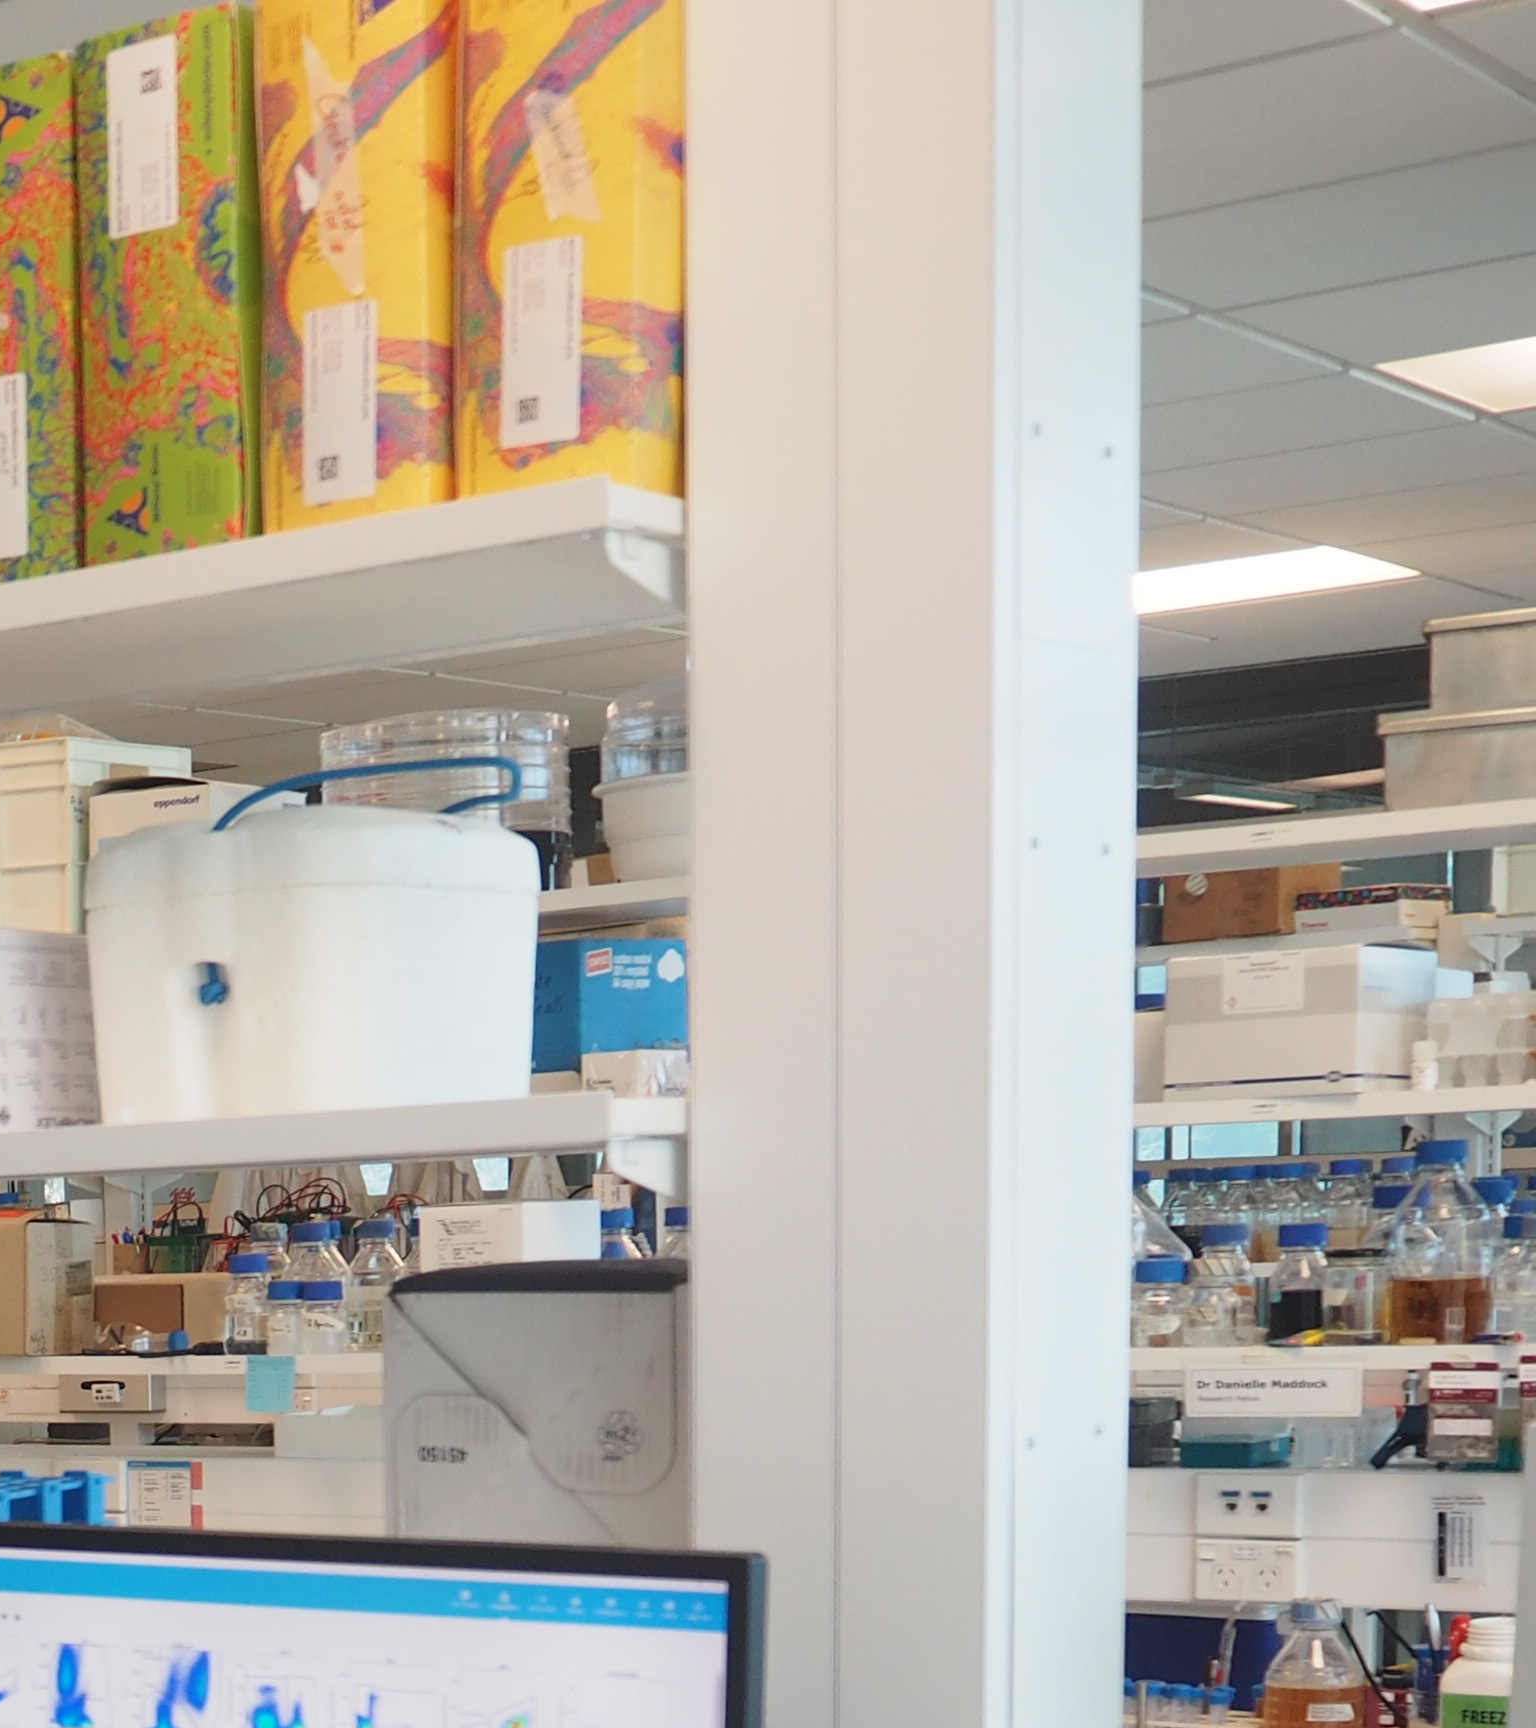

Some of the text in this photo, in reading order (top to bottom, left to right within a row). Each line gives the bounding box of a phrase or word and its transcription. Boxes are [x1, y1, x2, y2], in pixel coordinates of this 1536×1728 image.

[153, 794, 201, 809] eppendorf
[1196, 1379, 1328, 1390] Dr Danielle Maddock
[1461, 1709, 1507, 1725] FREEZ
